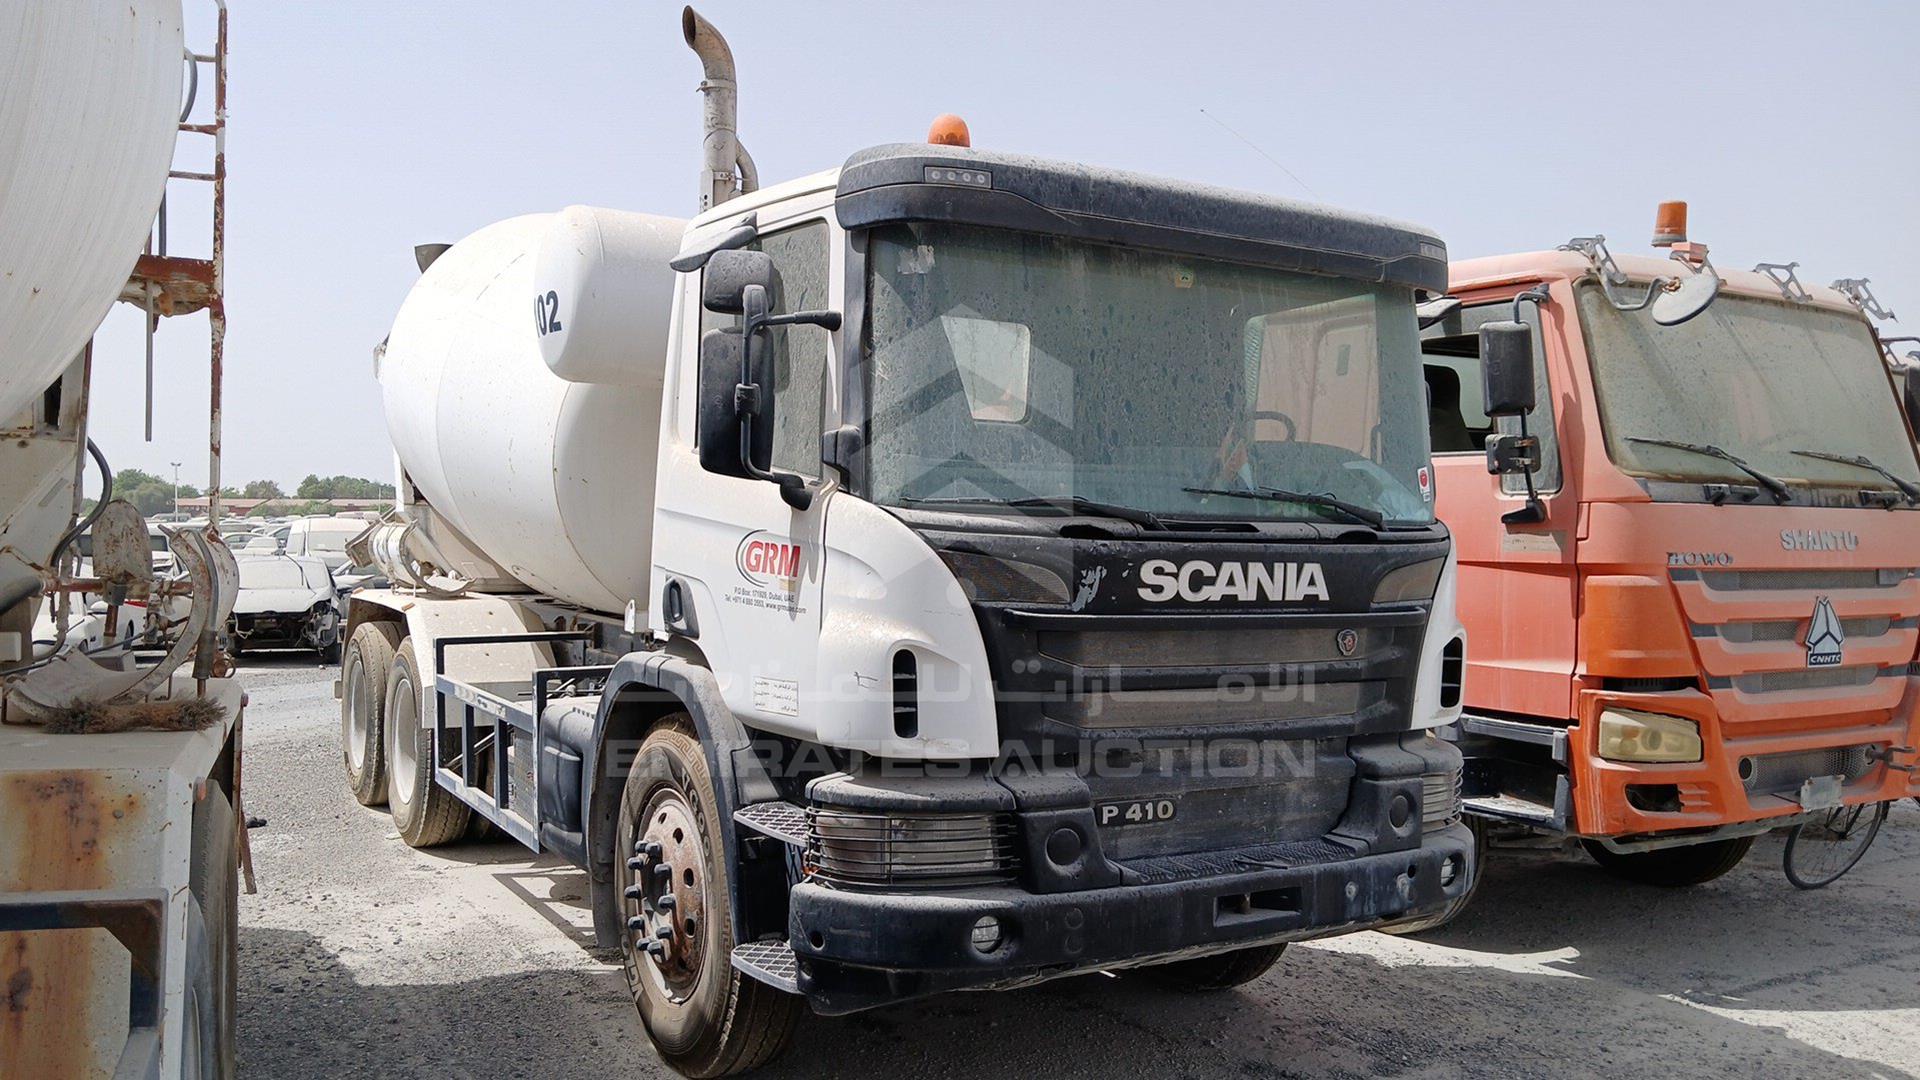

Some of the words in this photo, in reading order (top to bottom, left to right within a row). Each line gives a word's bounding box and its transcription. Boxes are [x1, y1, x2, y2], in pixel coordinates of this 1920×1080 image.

[533, 290, 562, 338] 02
[1780, 529, 1859, 551] SHANTU
[745, 540, 801, 578] GRM
[1666, 552, 1729, 566] HOWO
[1137, 559, 1330, 602] SCANIA
[1810, 654, 1841, 664] CNHTC
[1101, 805, 1119, 825] P
[1125, 801, 1174, 823] 410
